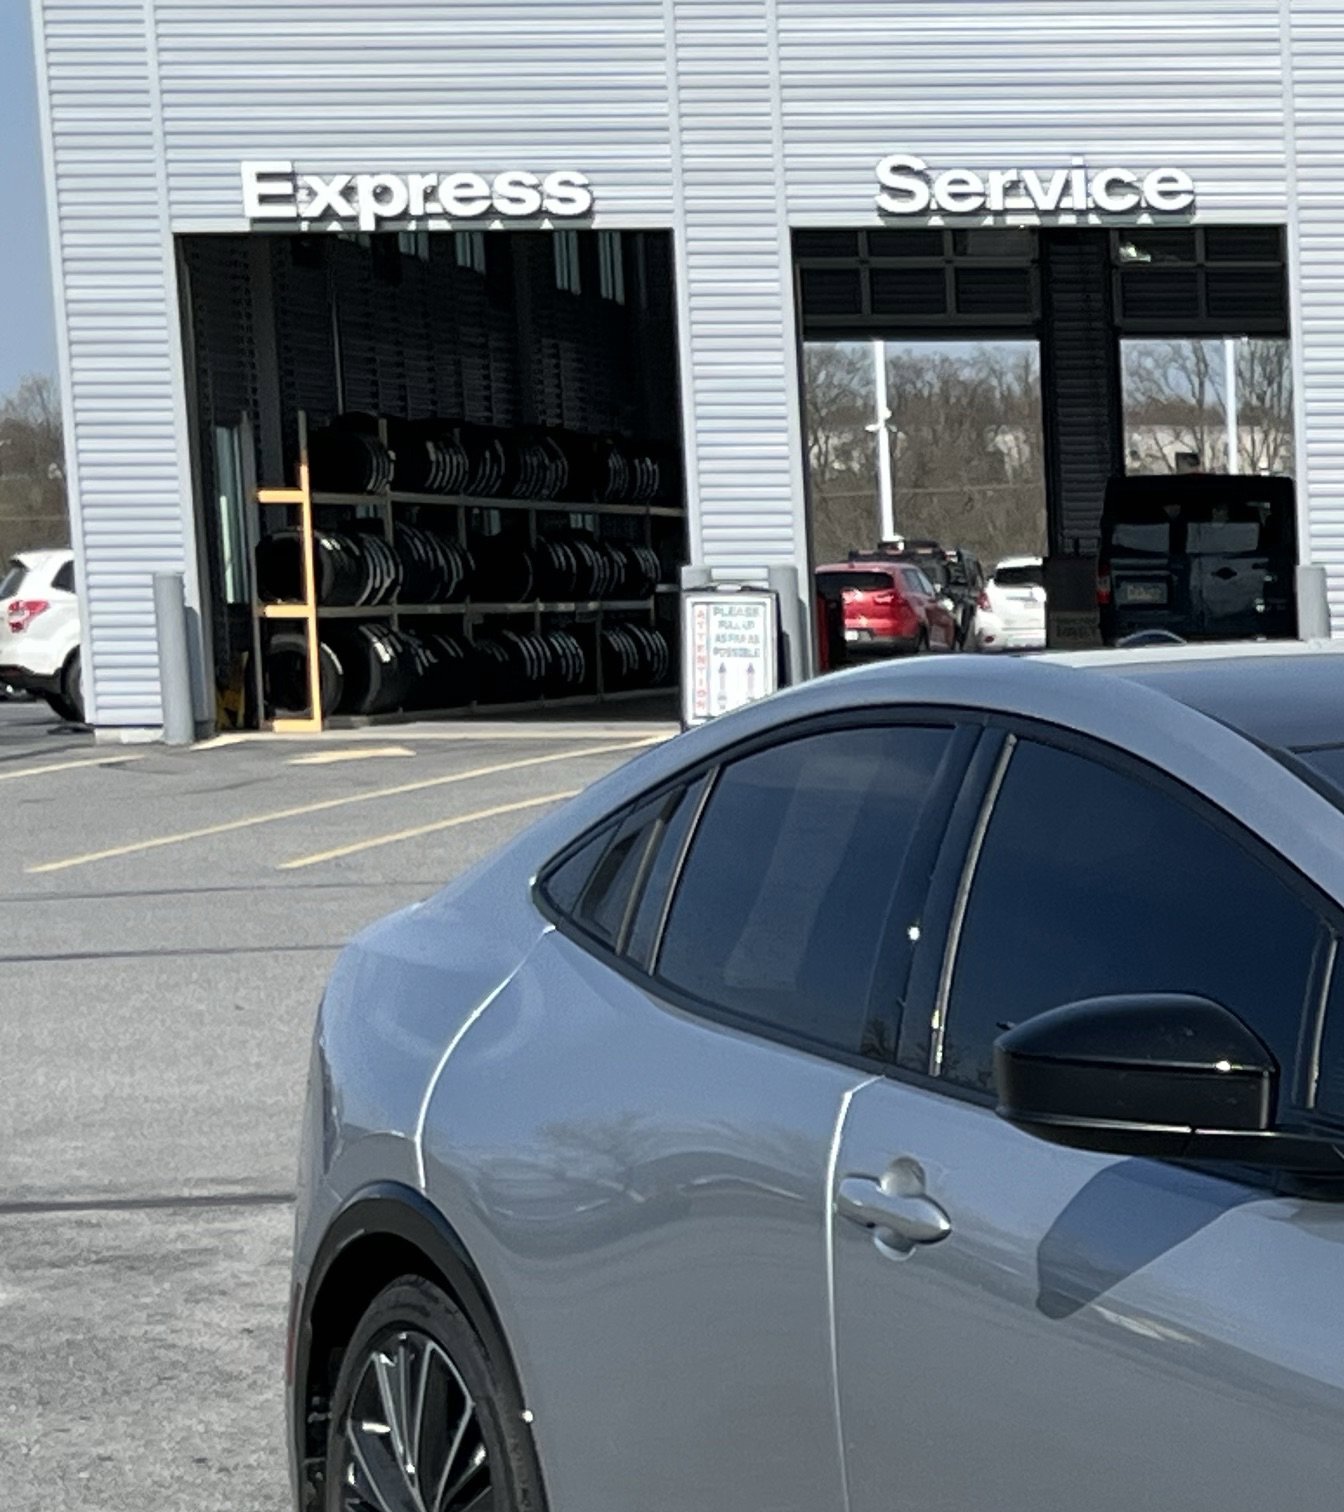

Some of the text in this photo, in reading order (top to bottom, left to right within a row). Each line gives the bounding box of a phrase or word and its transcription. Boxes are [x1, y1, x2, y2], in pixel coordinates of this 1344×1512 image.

[241, 161, 593, 231] Express
[874, 154, 1195, 213] Service
[713, 606, 760, 618] PLEASE
